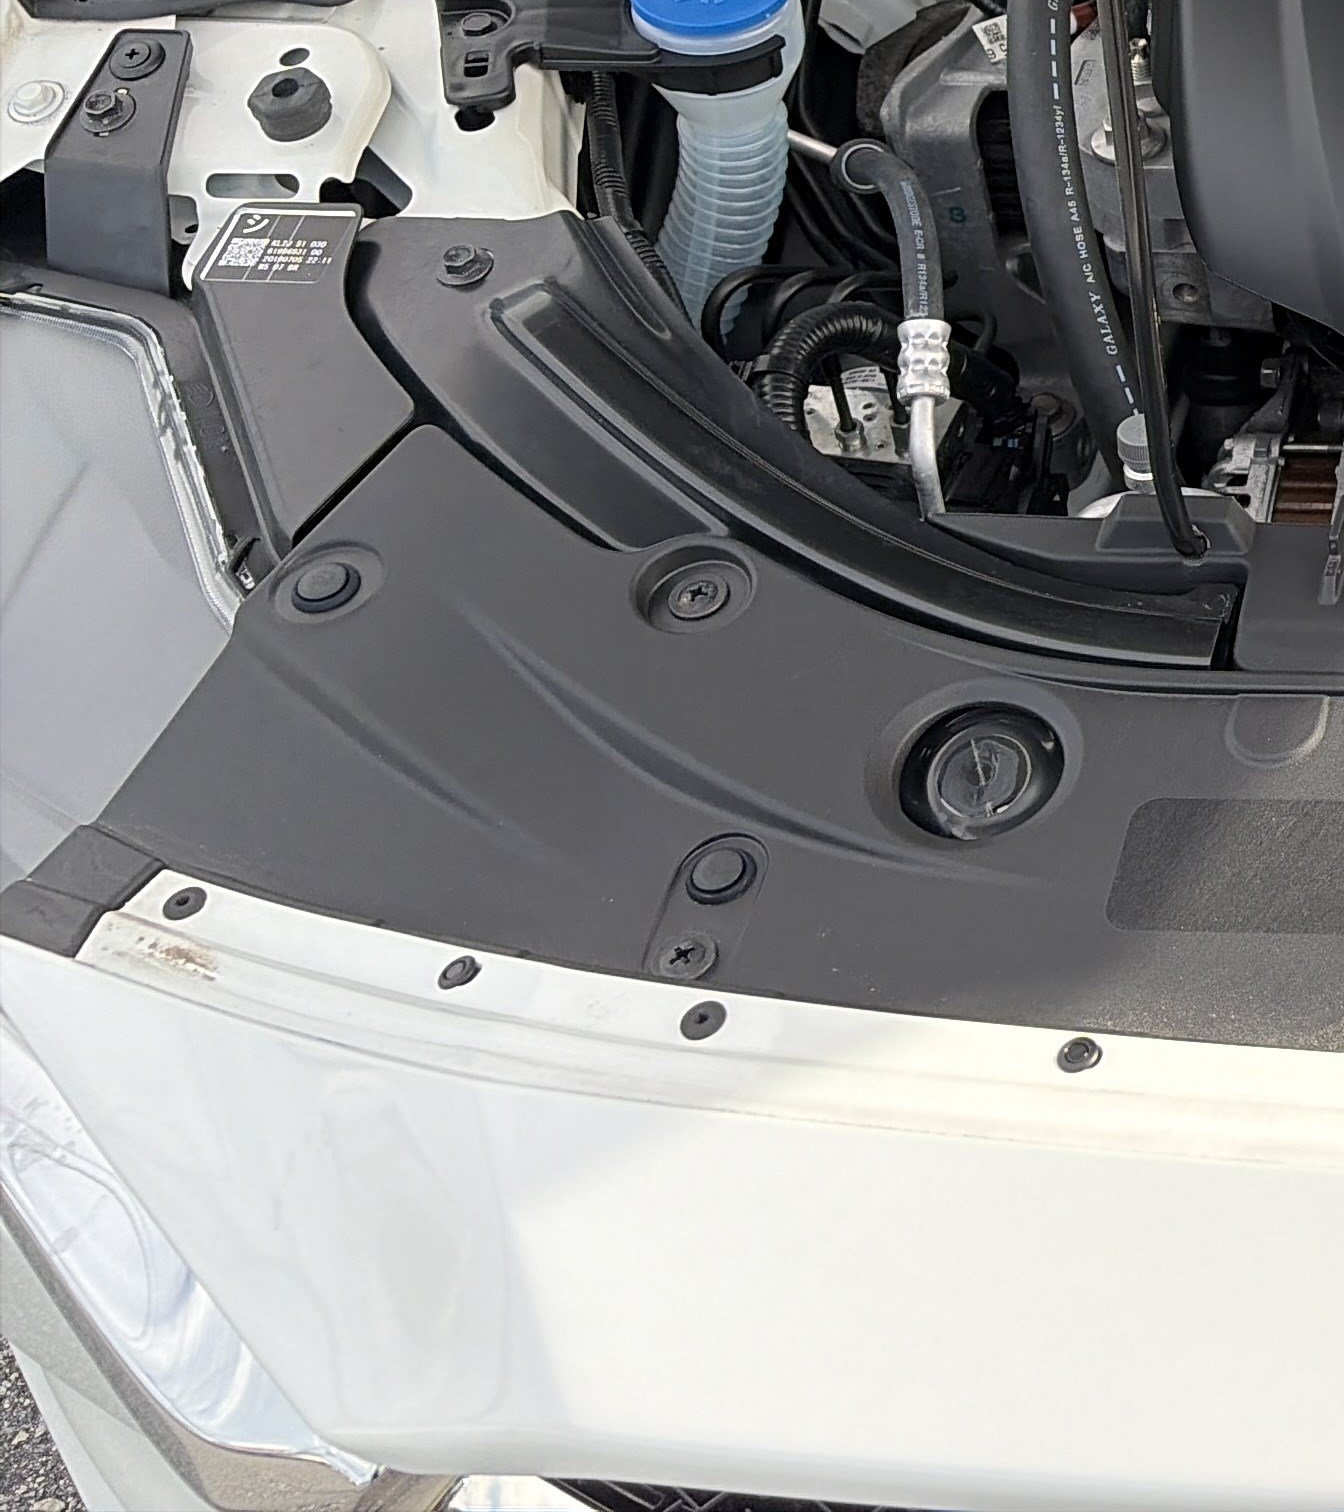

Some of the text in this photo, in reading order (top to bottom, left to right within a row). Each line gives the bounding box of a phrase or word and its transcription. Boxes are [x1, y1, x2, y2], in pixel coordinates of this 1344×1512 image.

[1068, 200, 1080, 221] A45
[1073, 226, 1088, 258] HOSE
[1082, 263, 1095, 283] A/C
[1088, 291, 1119, 355] GALAXY
